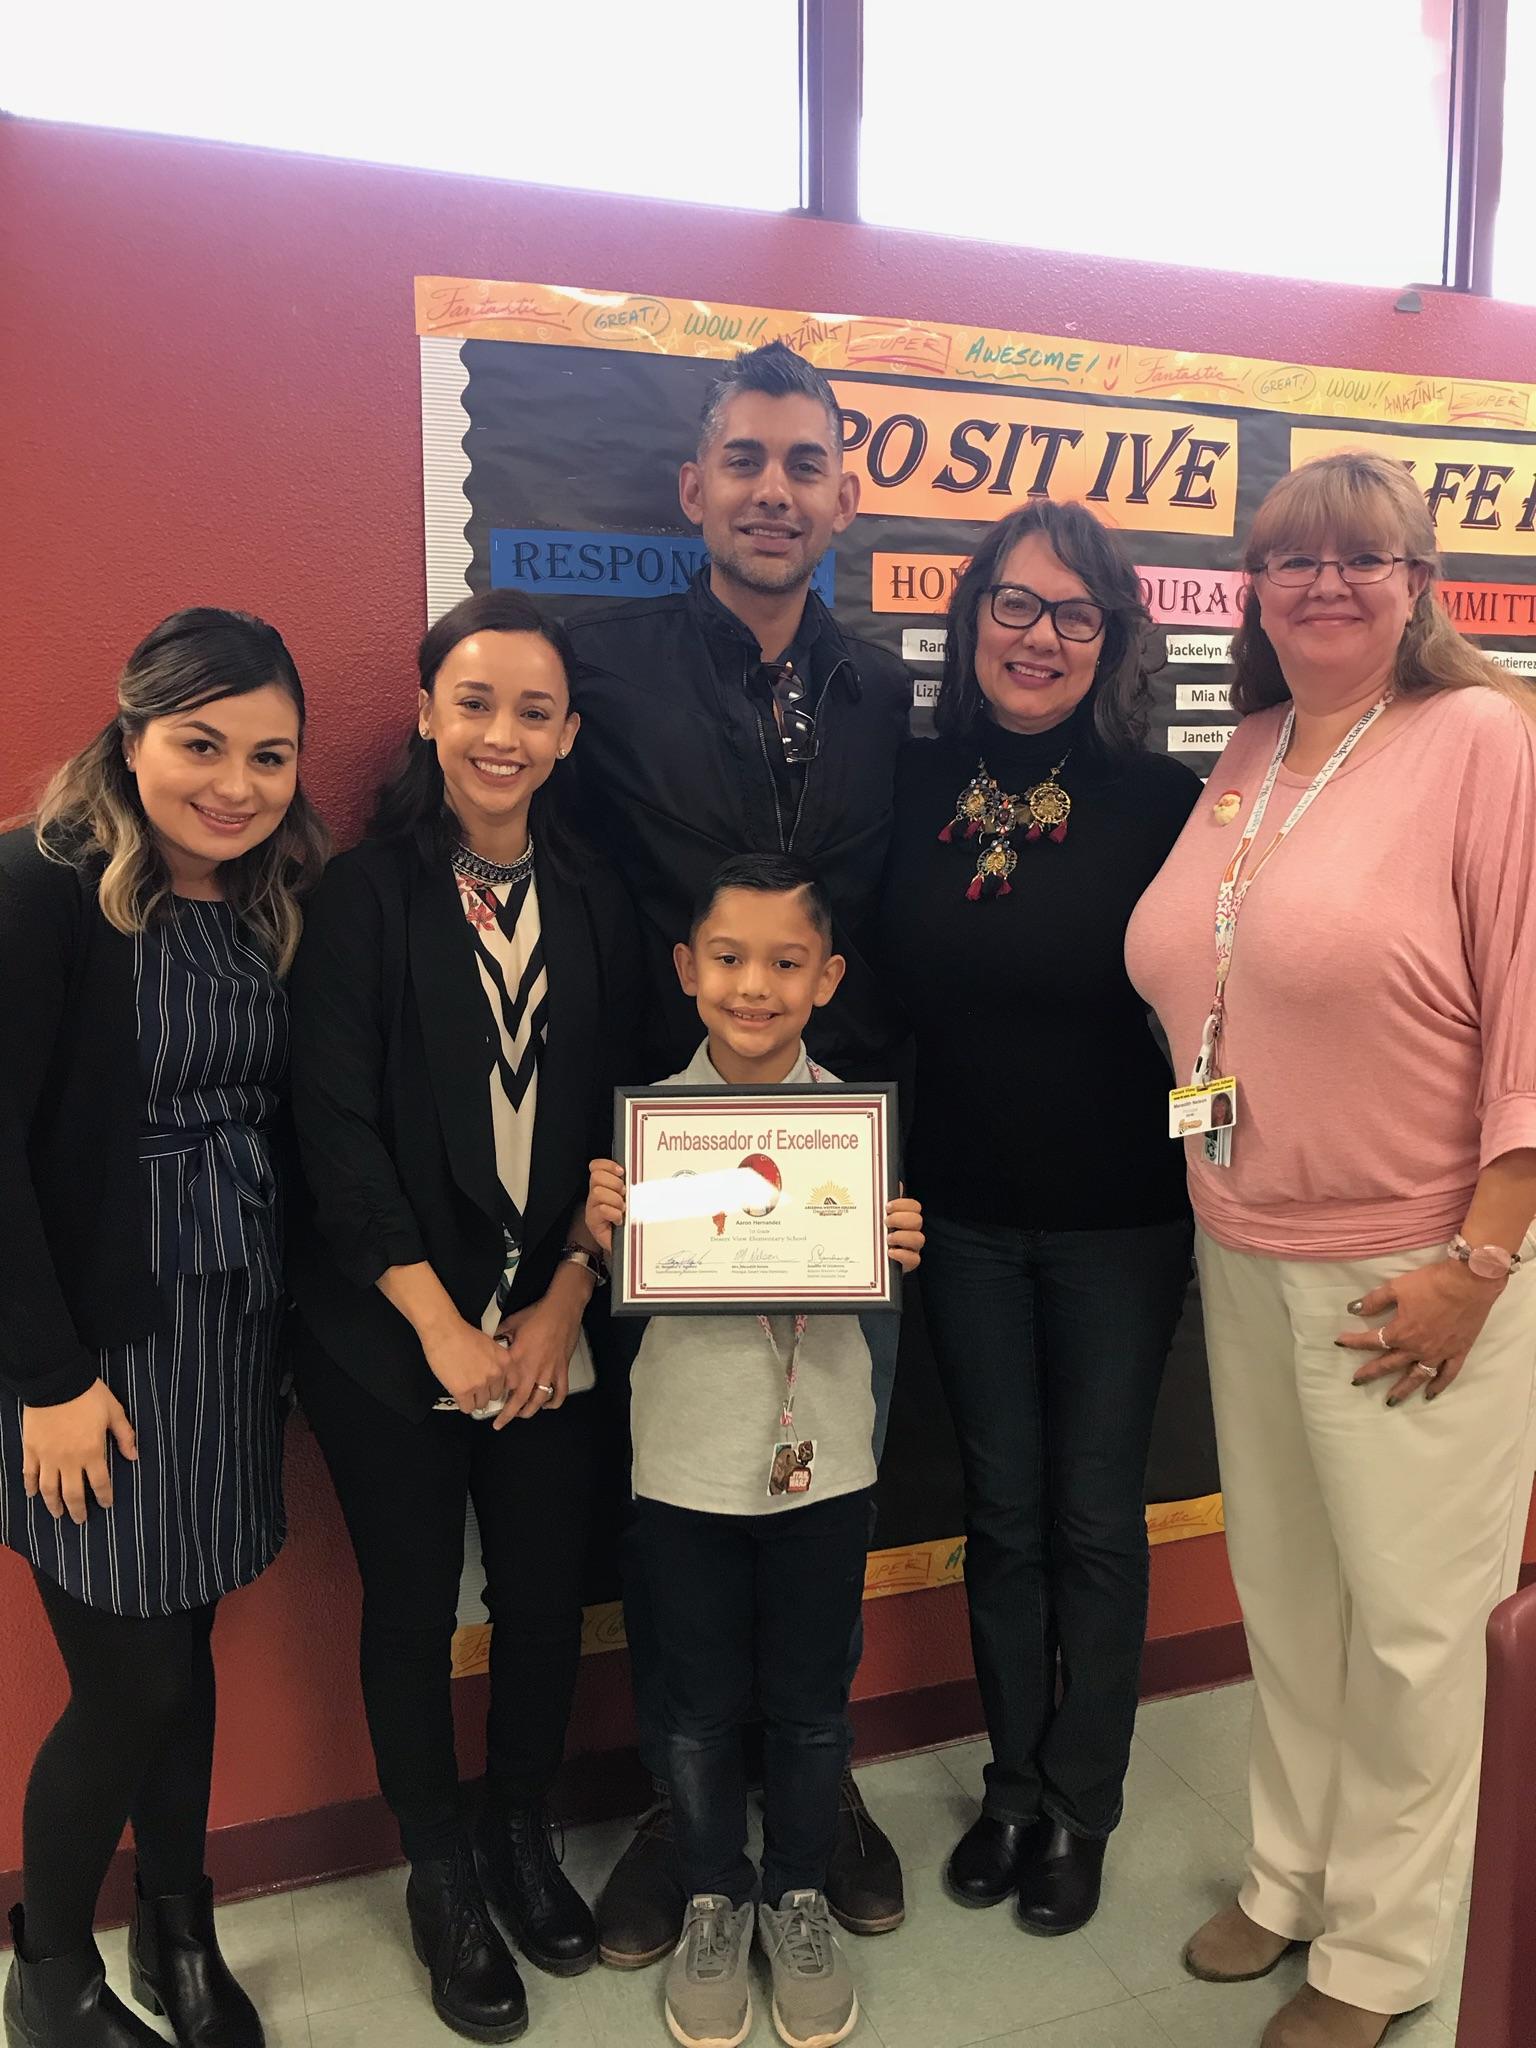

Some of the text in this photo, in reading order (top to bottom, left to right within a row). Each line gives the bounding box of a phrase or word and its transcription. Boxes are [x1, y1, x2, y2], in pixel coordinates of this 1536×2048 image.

[594, 306, 660, 329] GREAT!
[1260, 374, 1309, 395] GREAT!
[1168, 643, 1222, 658] Jackelyn
[1191, 690, 1215, 702] Mia
[1182, 731, 1223, 743] Janeth
[1332, 707, 1378, 759] Spectacular
[657, 1130, 859, 1150] Ambassador of Excellence
